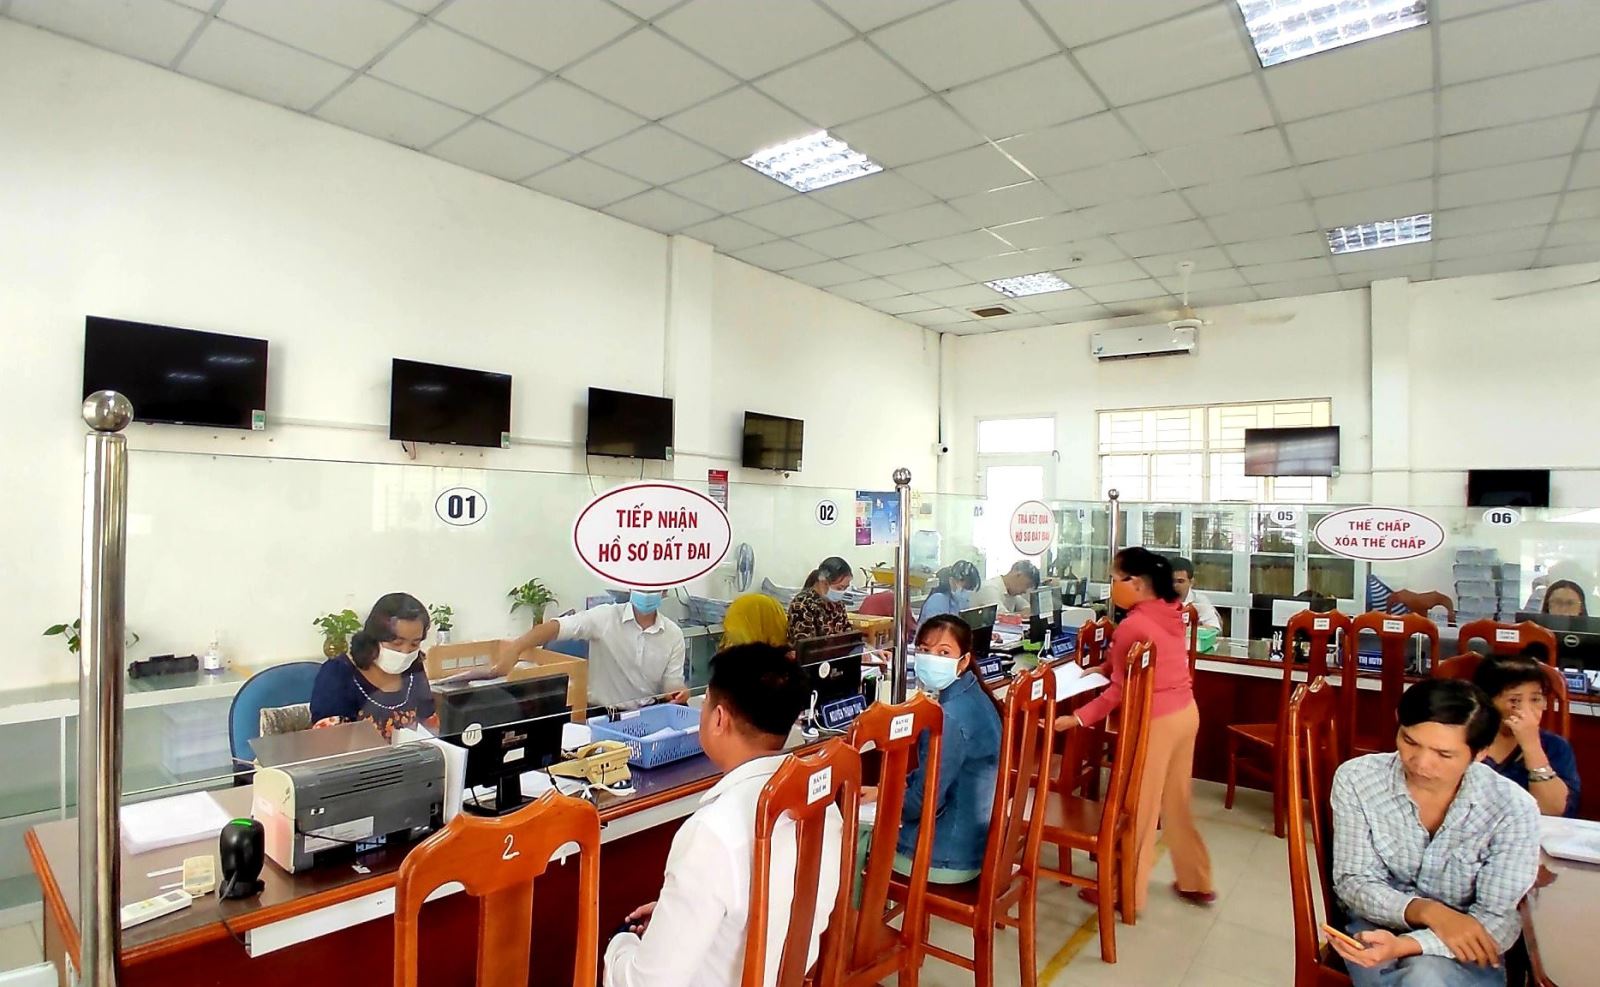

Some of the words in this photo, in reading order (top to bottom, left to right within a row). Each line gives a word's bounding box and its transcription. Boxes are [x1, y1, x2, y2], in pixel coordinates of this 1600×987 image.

[448, 494, 476, 519] 01
[819, 505, 834, 521] 02
[616, 503, 653, 528] TIẾP
[658, 507, 698, 532] NHẬN
[1277, 511, 1293, 521] 05
[1491, 512, 1512, 524] 06
[1348, 518, 1374, 531] THẾ
[1377, 519, 1411, 532] CHẤP
[598, 535, 621, 562] HỒ
[627, 540, 650, 561] SƠ
[653, 536, 682, 561] ĐẤT
[687, 543, 711, 560] ĐAI
[1334, 534, 1358, 547] XÓA
[1362, 535, 1386, 548] THẾ
[1391, 536, 1427, 549] CHẤP
[502, 834, 520, 860] 2
